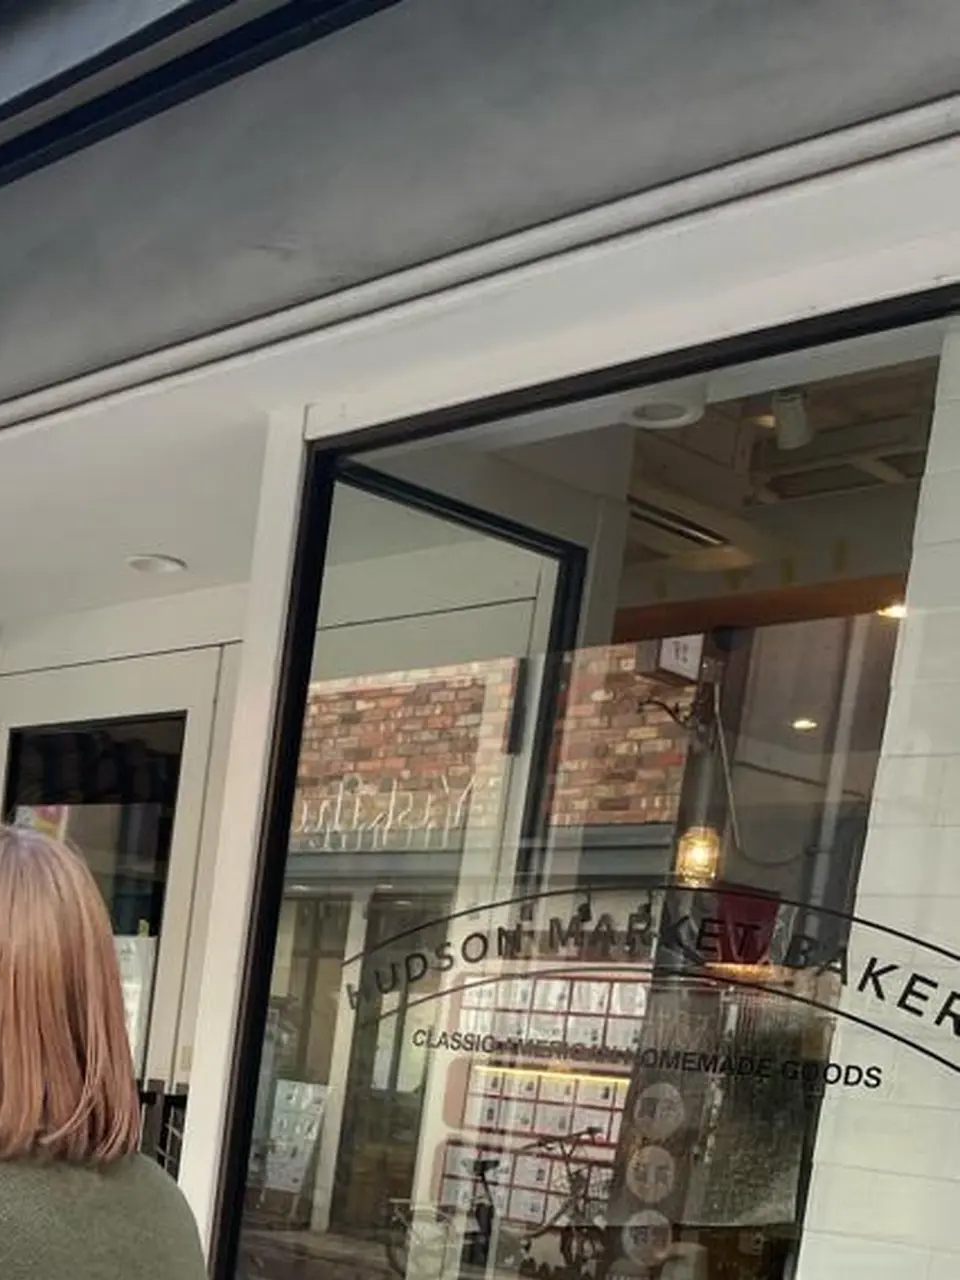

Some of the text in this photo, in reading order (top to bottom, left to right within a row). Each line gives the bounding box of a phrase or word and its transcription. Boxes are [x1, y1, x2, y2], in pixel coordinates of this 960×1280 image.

[346, 923, 522, 1010] HUDSON
[548, 911, 762, 959] MARKET
[412, 1028, 498, 1053] CLASSIC
[781, 1059, 883, 1089] GOODS
